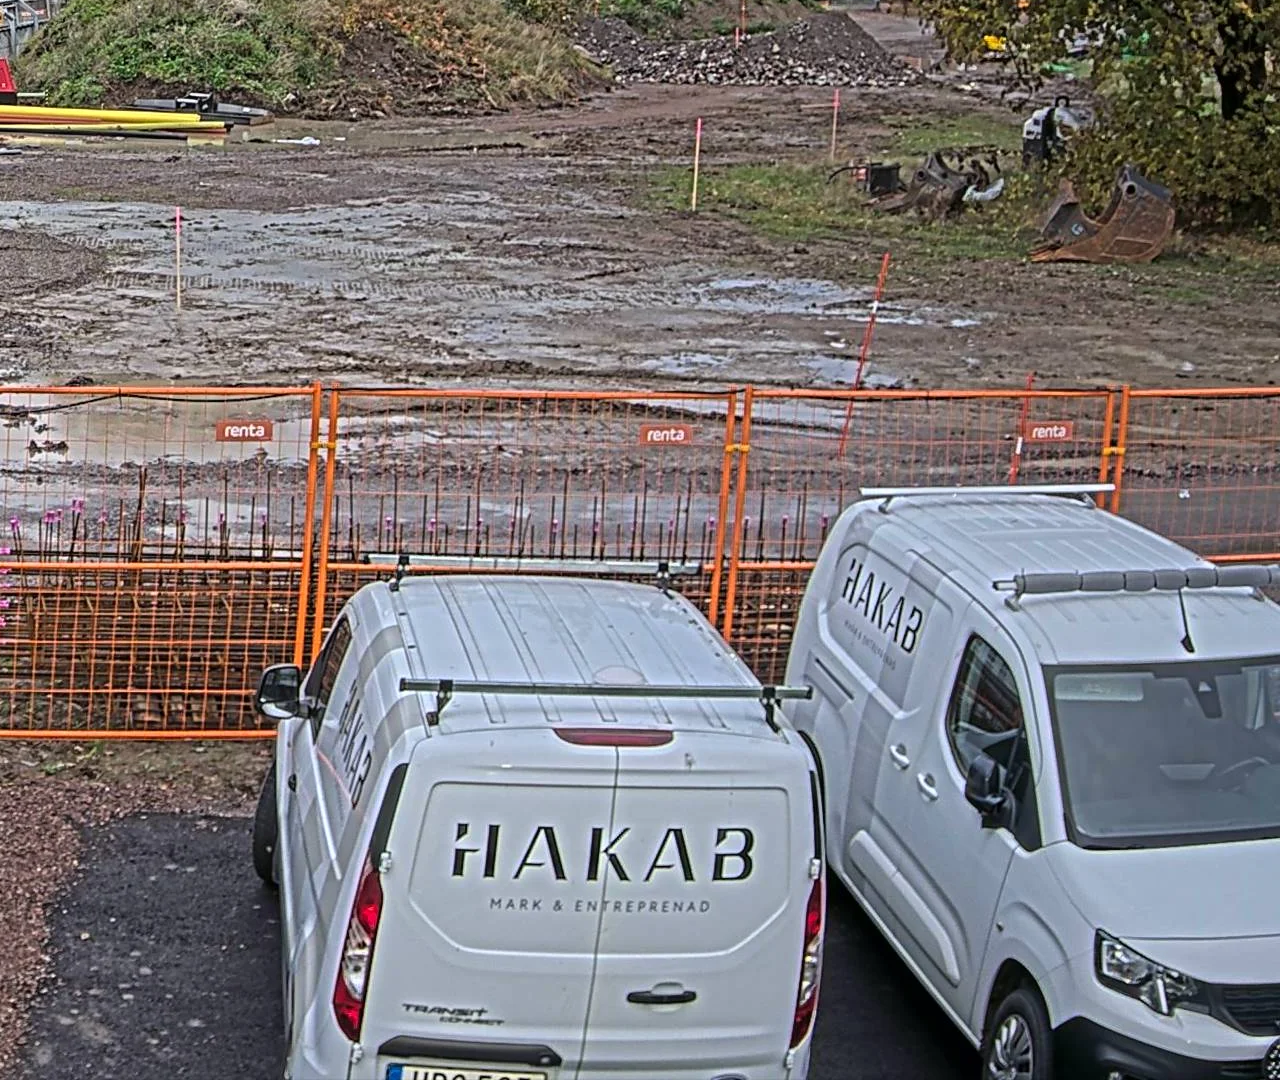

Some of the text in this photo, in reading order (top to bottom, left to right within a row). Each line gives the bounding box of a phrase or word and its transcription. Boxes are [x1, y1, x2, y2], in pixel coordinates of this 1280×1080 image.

[225, 424, 265, 437] renta
[647, 428, 685, 441] renta
[1032, 425, 1067, 439] renta
[842, 558, 923, 653] HAKAB
[452, 823, 755, 882] HAKAB
[490, 897, 711, 913] MARK & ENTREPRENAD
